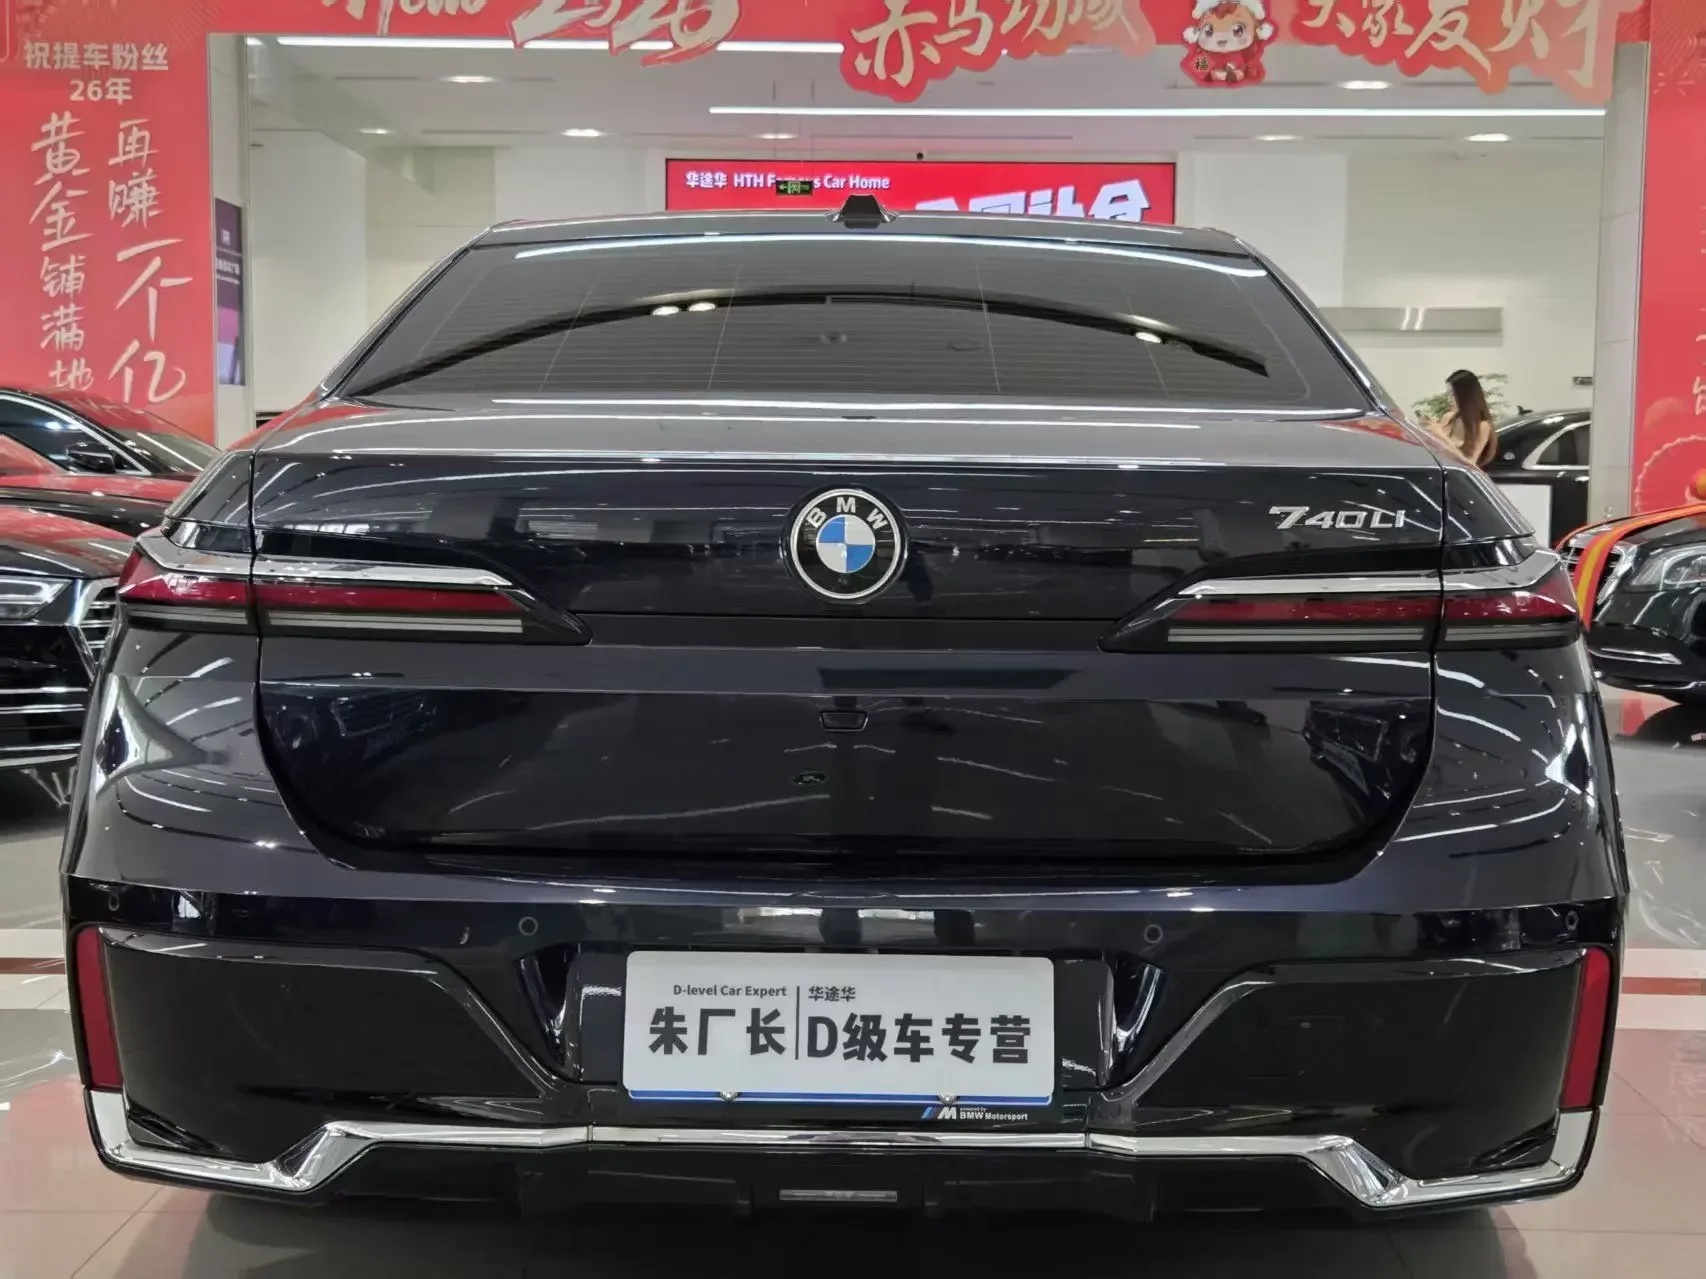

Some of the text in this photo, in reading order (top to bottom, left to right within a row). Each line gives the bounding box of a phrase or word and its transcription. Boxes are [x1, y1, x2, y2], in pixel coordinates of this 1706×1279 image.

[24, 41, 169, 71] 祝提车粉丝
[69, 77, 133, 105] 26年
[685, 170, 728, 189] 华途华
[733, 173, 764, 188] HTH
[823, 174, 846, 189] Car
[849, 176, 890, 189] Home
[29, 110, 96, 392] 黄金铺满地
[107, 117, 193, 404] 再赚一个亿
[805, 496, 889, 530] BMW
[673, 984, 787, 999] D-level Car Expert
[807, 985, 857, 1002] 华途华
[648, 1006, 787, 1056] 朱厂长
[807, 1012, 1031, 1064] D级车专营
[959, 1111, 1028, 1121] BMW Motorsport
